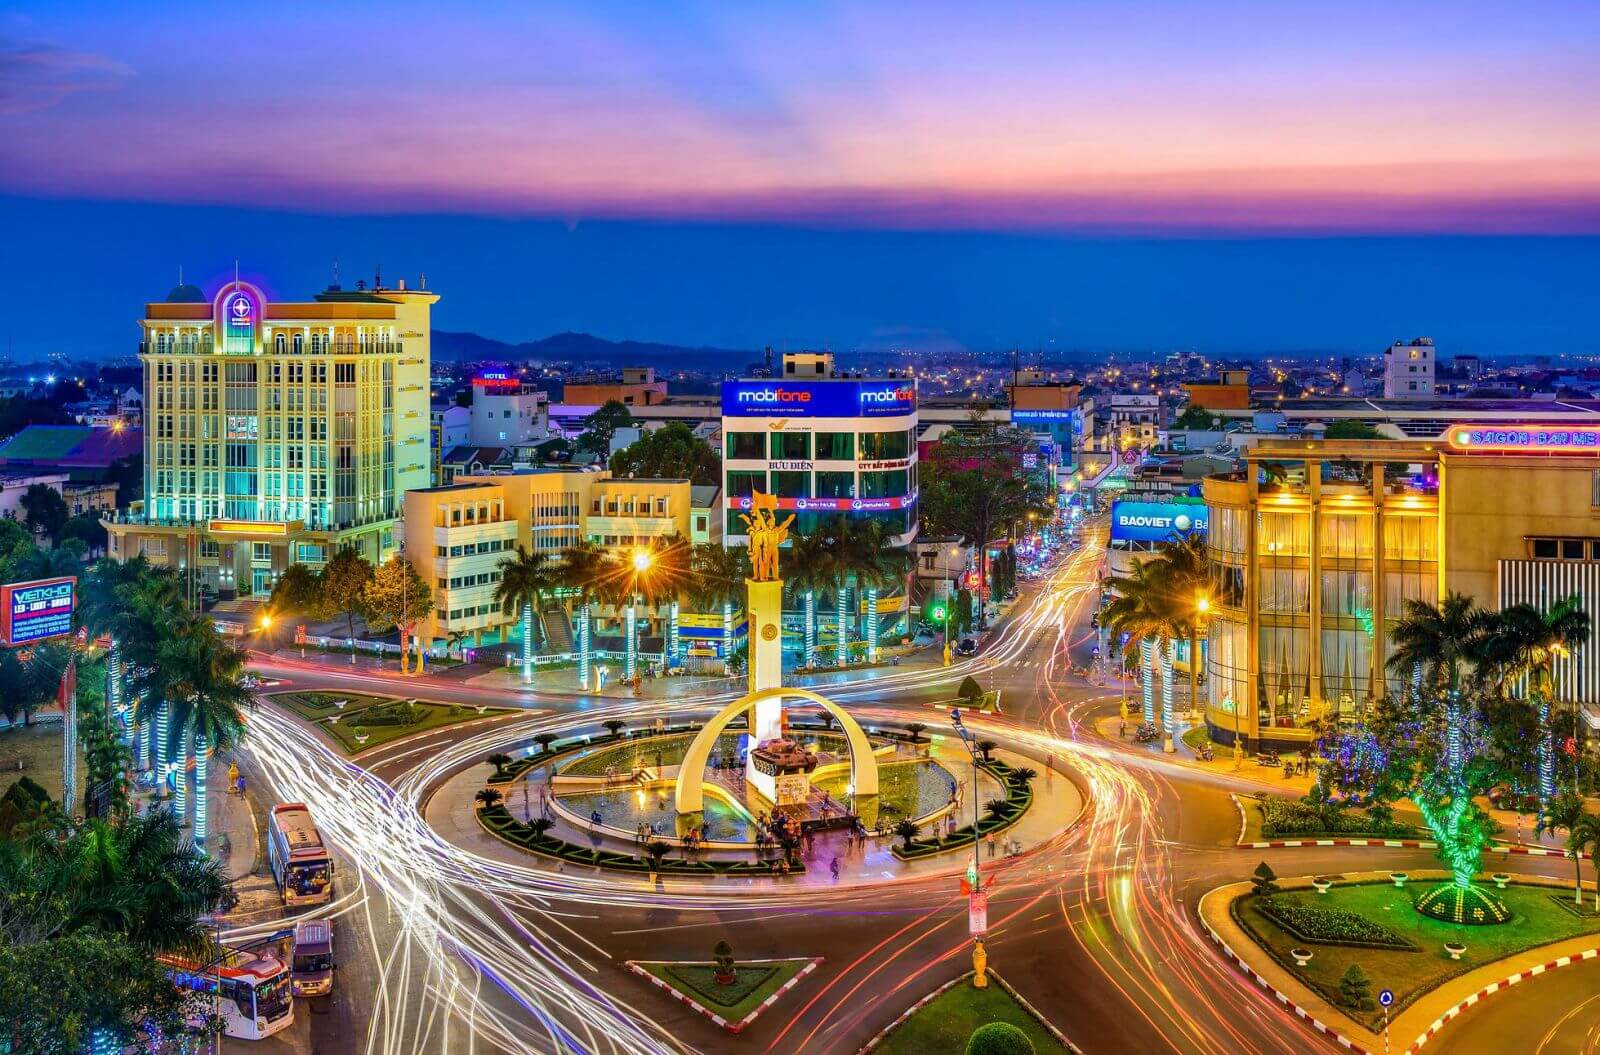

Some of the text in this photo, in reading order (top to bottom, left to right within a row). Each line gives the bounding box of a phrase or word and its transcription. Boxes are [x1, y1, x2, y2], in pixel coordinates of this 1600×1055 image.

[739, 389, 811, 402] mobifone
[861, 388, 913, 402] mobifone
[769, 460, 814, 472] BƯU ĐIỆN
[1119, 516, 1173, 528] BAOVIET
